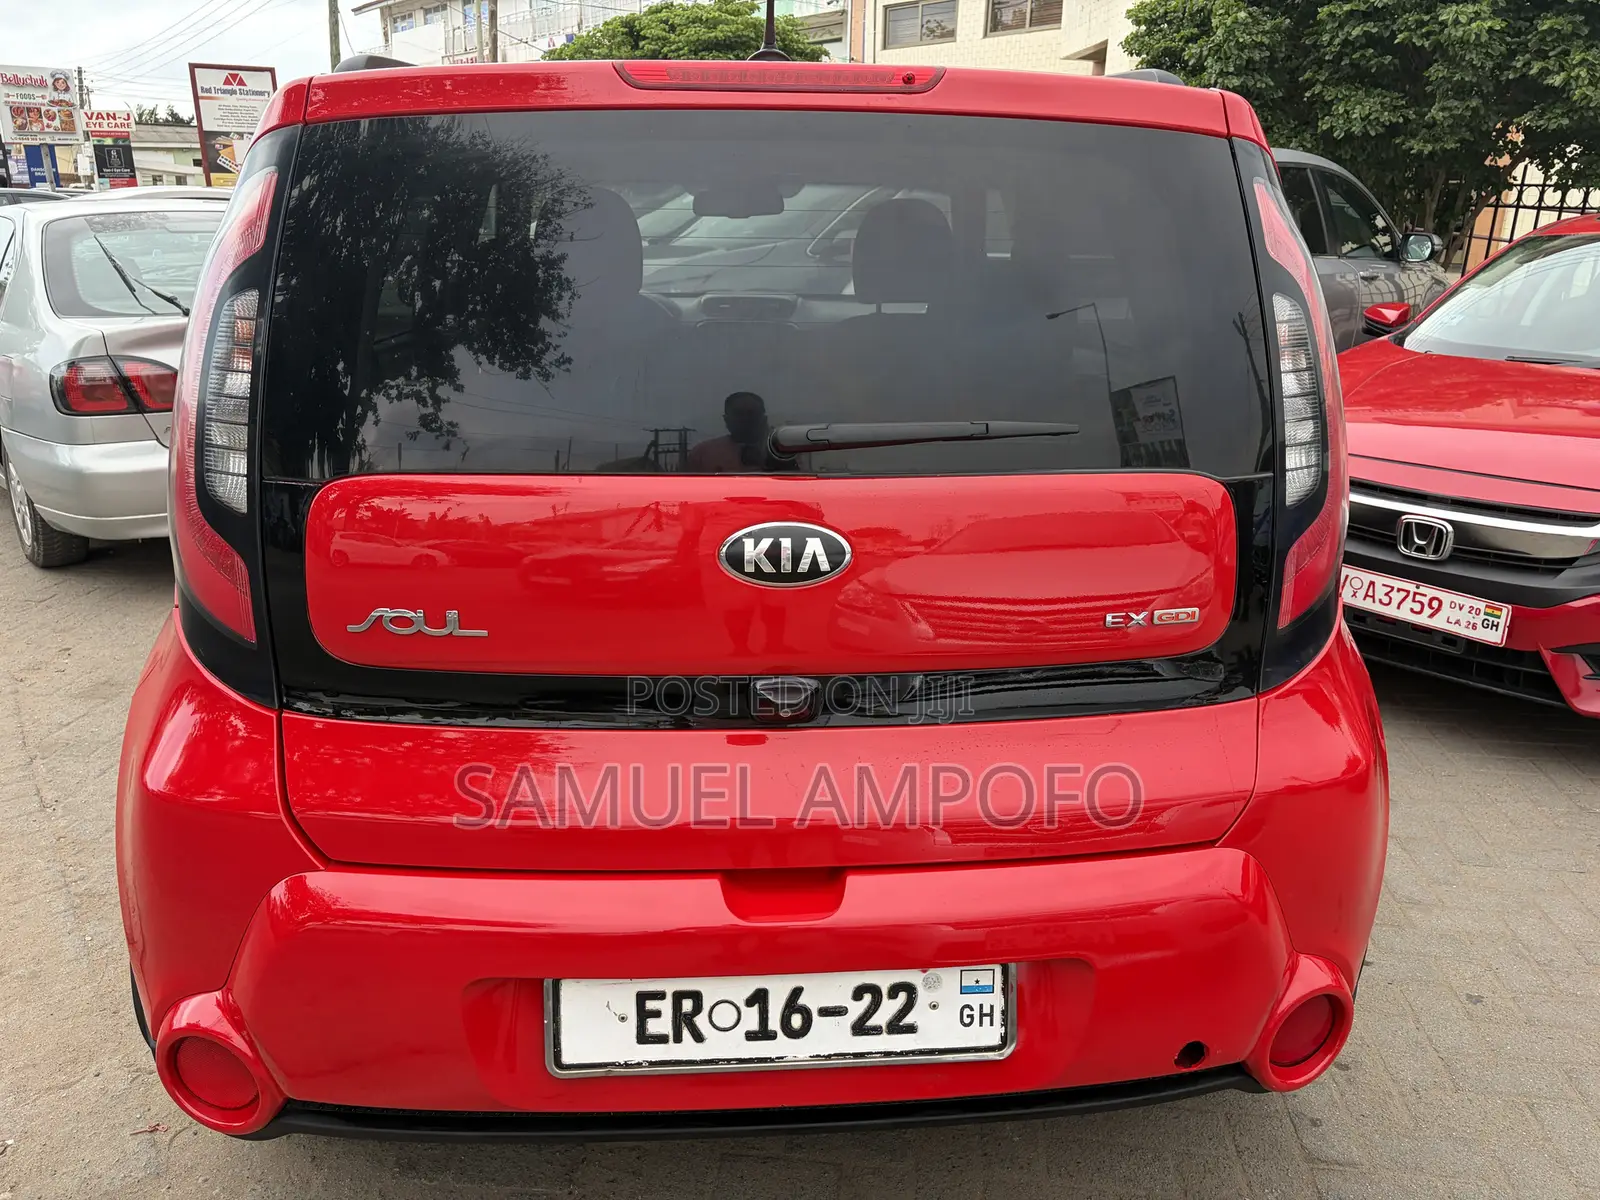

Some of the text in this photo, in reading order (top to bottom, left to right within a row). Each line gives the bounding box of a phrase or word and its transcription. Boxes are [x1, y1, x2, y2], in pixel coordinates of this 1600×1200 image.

[200, 86, 270, 98] Red Triangle Stationery
[83, 112, 131, 121] VAN-J
[742, 537, 831, 573] KIA
[1363, 580, 1443, 619] A3759
[1449, 600, 1481, 616] DV 20
[346, 607, 488, 637] SOUL
[1105, 610, 1197, 628] EX GDI
[1446, 616, 1461, 627] LA
[1481, 618, 1500, 632] GH
[959, 1003, 994, 1028] GH
